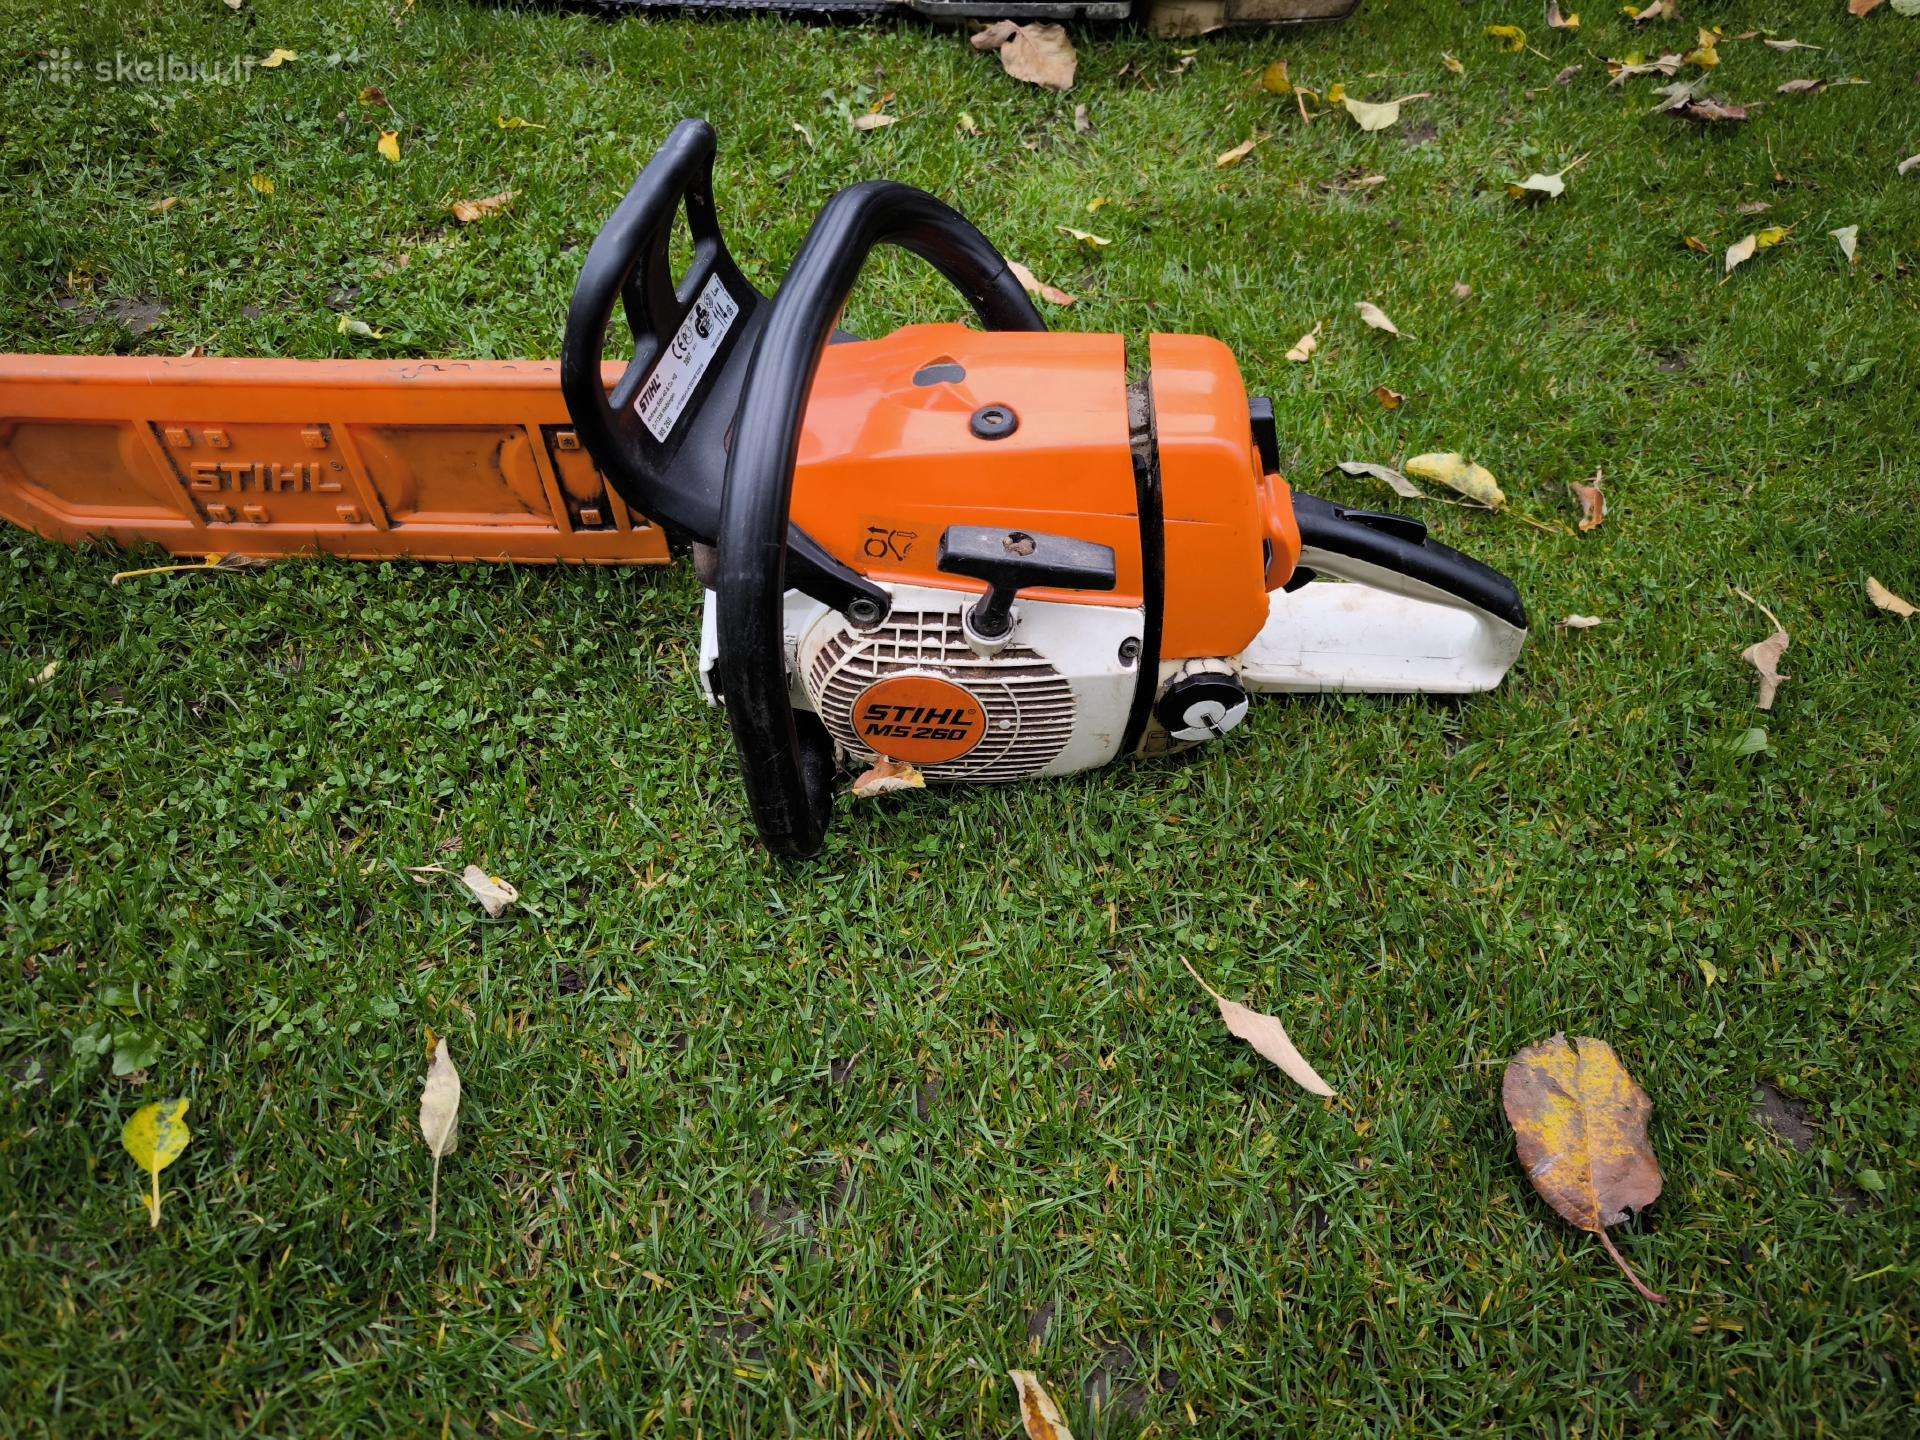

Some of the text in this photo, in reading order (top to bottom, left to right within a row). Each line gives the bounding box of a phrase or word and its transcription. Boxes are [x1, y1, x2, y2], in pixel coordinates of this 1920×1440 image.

[638, 378, 662, 414] STIHL
[190, 462, 342, 492] STIHL
[863, 704, 973, 726] STIHL
[865, 723, 968, 741] MS 260
